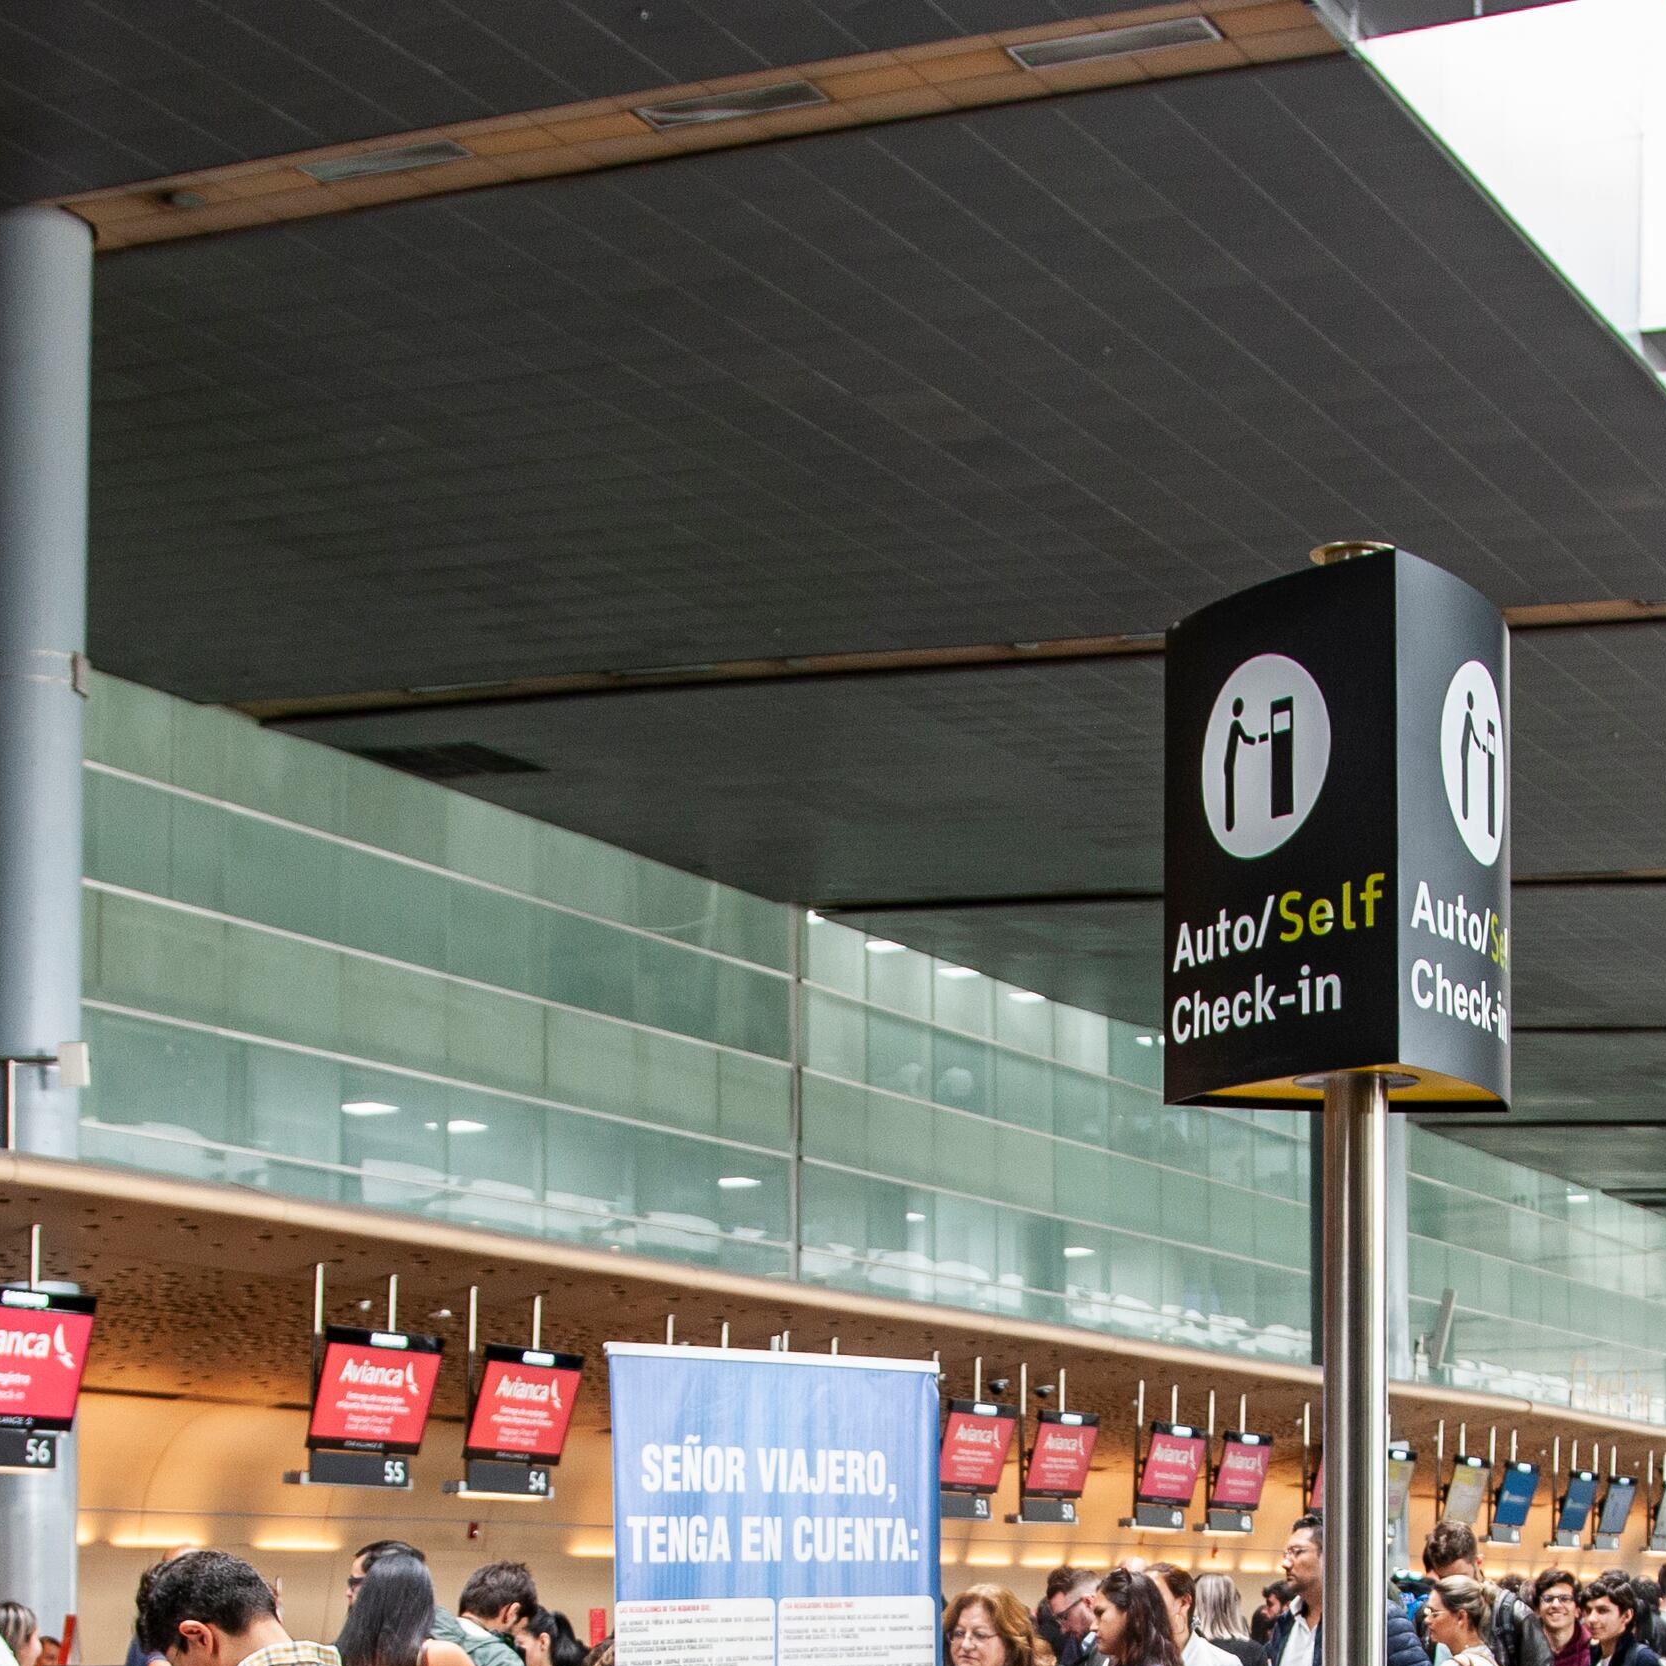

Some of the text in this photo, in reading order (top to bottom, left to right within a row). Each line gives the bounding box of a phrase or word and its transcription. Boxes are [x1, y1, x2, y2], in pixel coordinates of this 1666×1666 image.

[1172, 872, 1385, 973] Auto/Self
[1171, 964, 1343, 1045] Check-in
[1411, 958, 1508, 1045] Check-in
[339, 1358, 404, 1388] Avianca
[494, 1374, 550, 1404] Avianca
[954, 1423, 993, 1444] Avianca
[1042, 1431, 1080, 1451] Avianca
[25, 1438, 51, 1464] 56
[1152, 1443, 1190, 1465] Avianca
[1226, 1450, 1259, 1472] Avianca
[383, 1460, 406, 1484] 55
[528, 1471, 547, 1492] 54
[641, 1434, 747, 1493] SEÑOR
[756, 1447, 898, 1503] VIAJERO,
[975, 1499, 988, 1516] 51
[626, 1515, 920, 1564] TENGA EN CUENTA:
